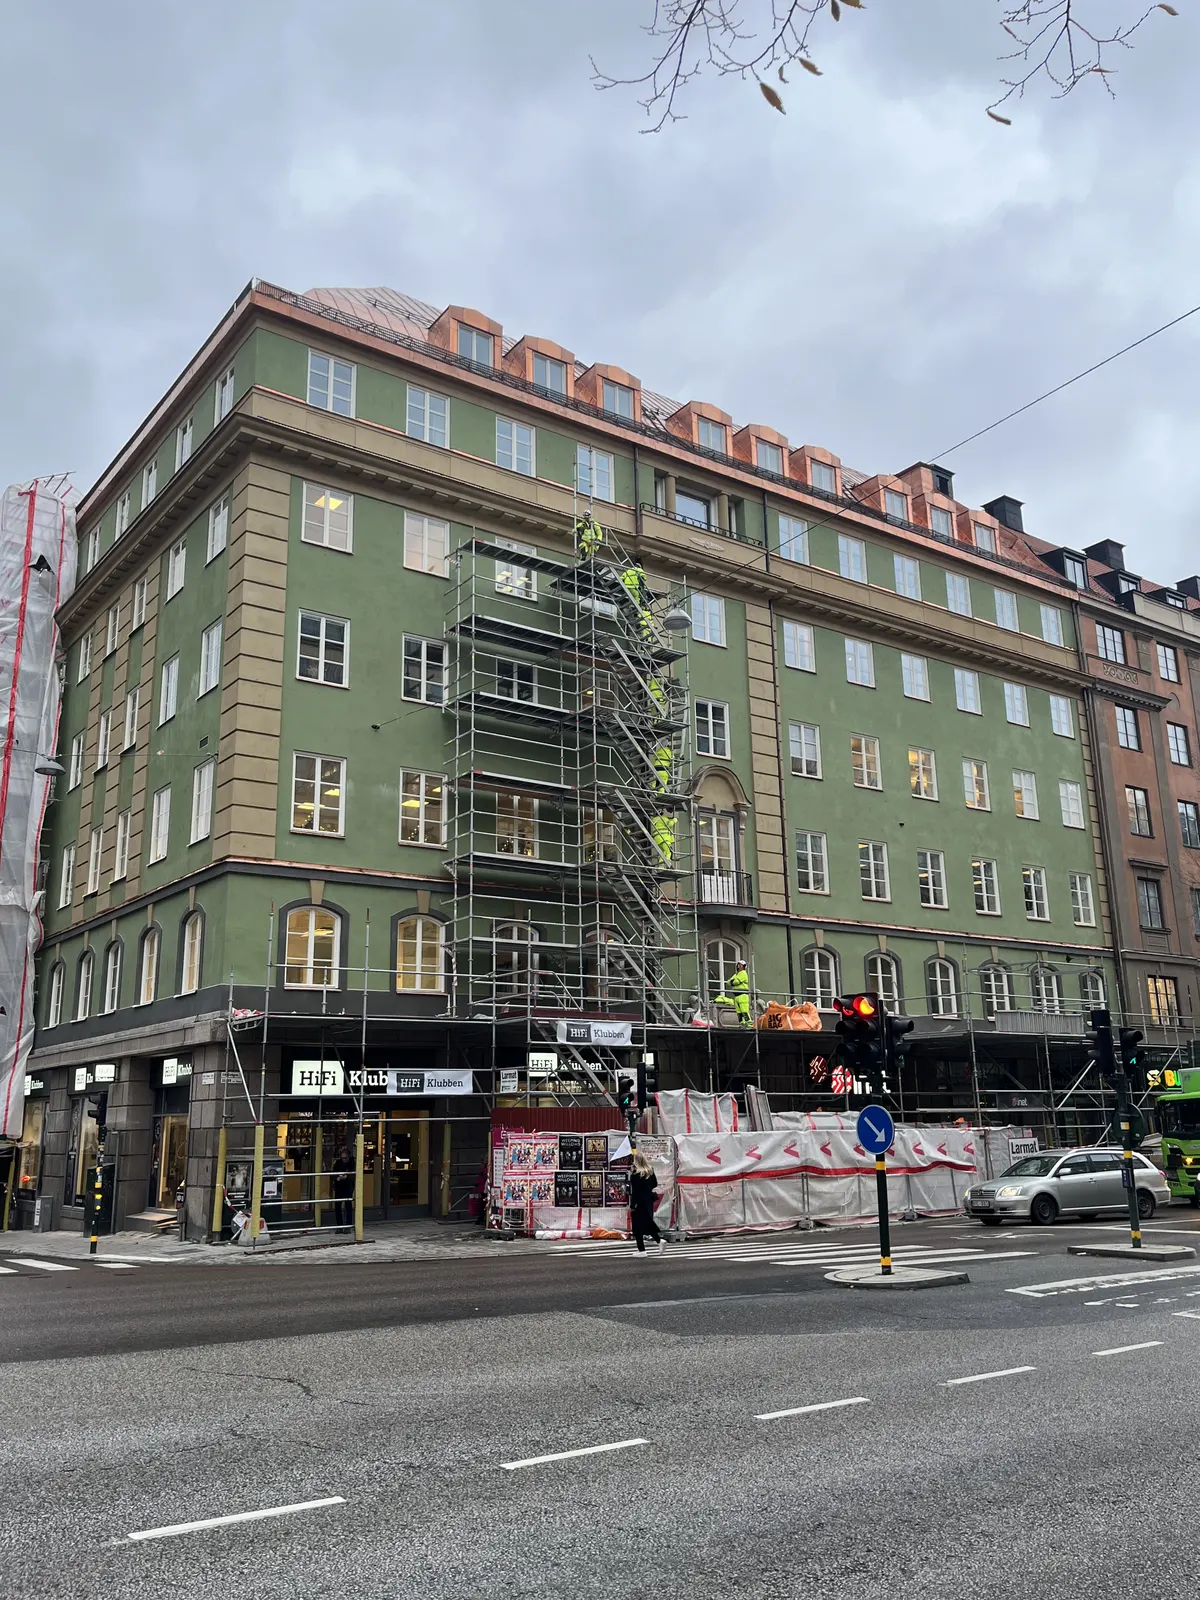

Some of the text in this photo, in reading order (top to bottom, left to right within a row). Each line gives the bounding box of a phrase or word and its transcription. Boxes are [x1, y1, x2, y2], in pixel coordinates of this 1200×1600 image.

[768, 1013, 782, 1023] BIG
[570, 1028, 625, 1039] HiFi Klubben
[531, 1059, 553, 1070] HiFi
[299, 1071, 337, 1086] HiFi
[501, 1071, 517, 1080] Larmat
[400, 1078, 463, 1089] HiFi Klubben
[1010, 1140, 1038, 1155] Larmat
